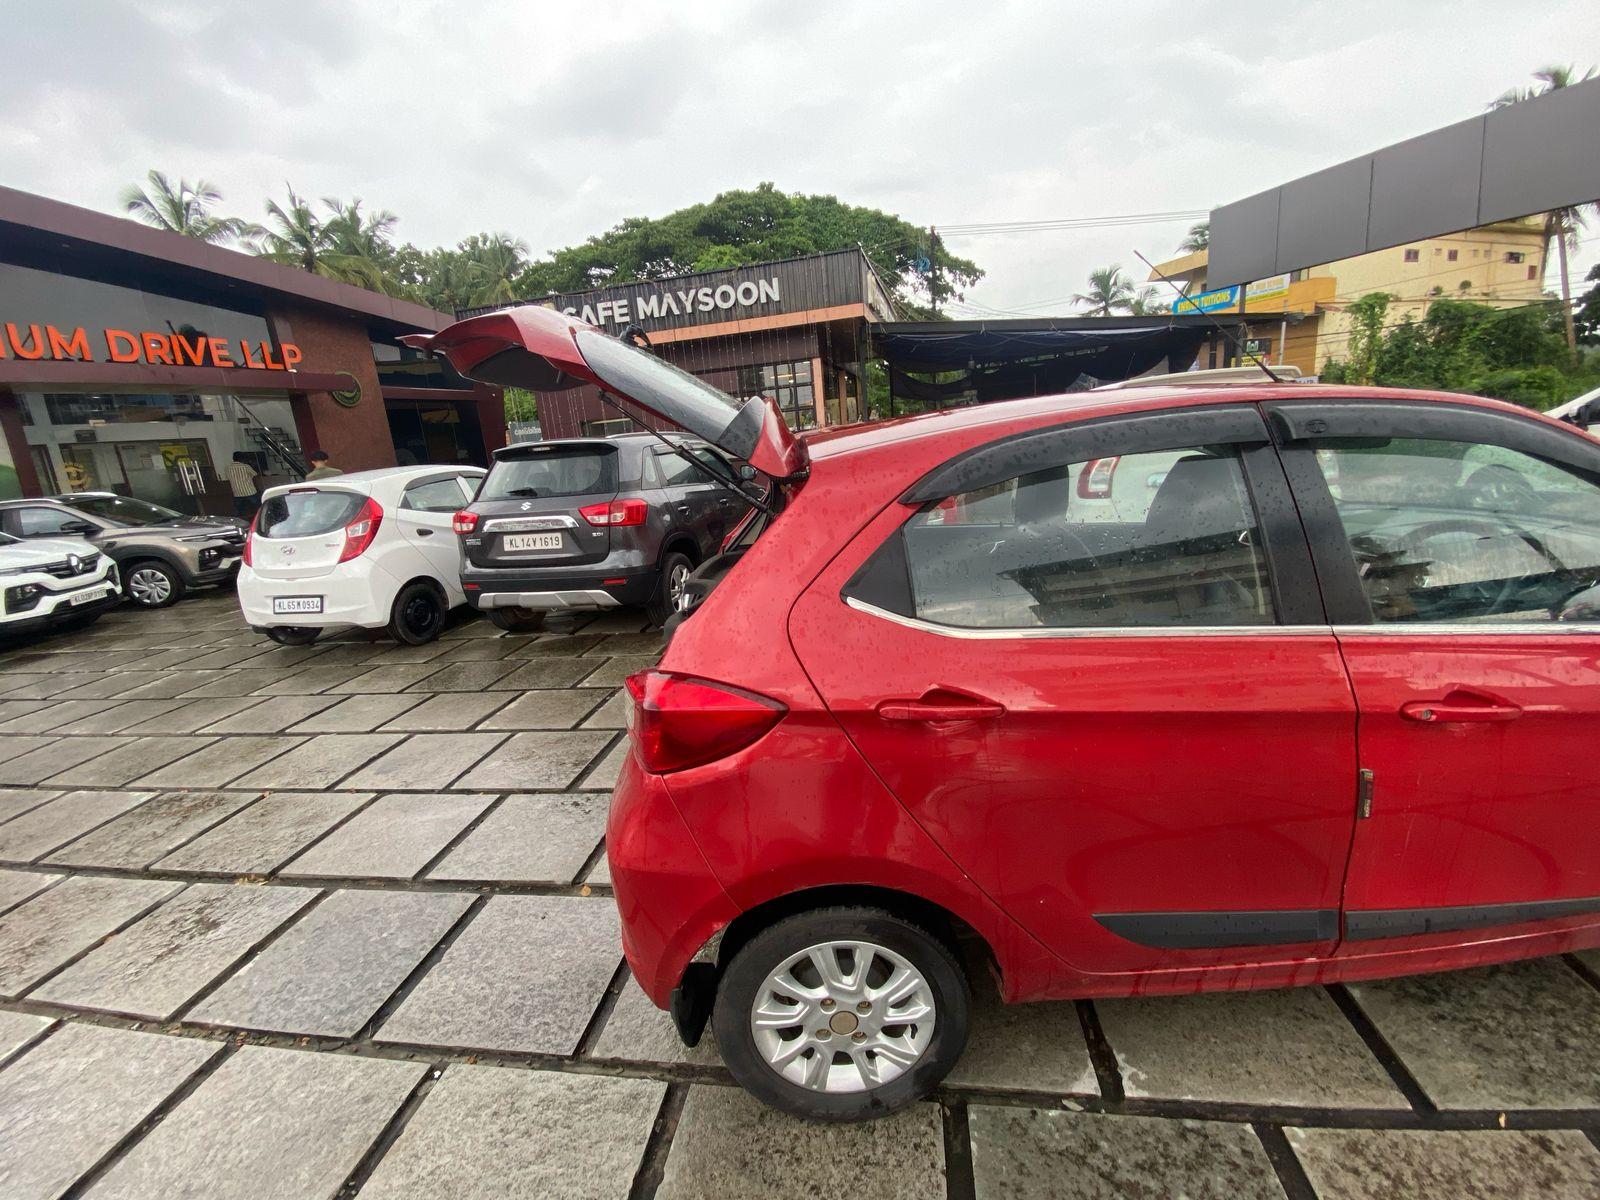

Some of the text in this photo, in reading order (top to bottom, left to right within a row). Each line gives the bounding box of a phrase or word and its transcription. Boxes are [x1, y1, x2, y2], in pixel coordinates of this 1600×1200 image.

[638, 278, 780, 320] MAYSOON
[0, 323, 302, 371] UM DRIVE LLP
